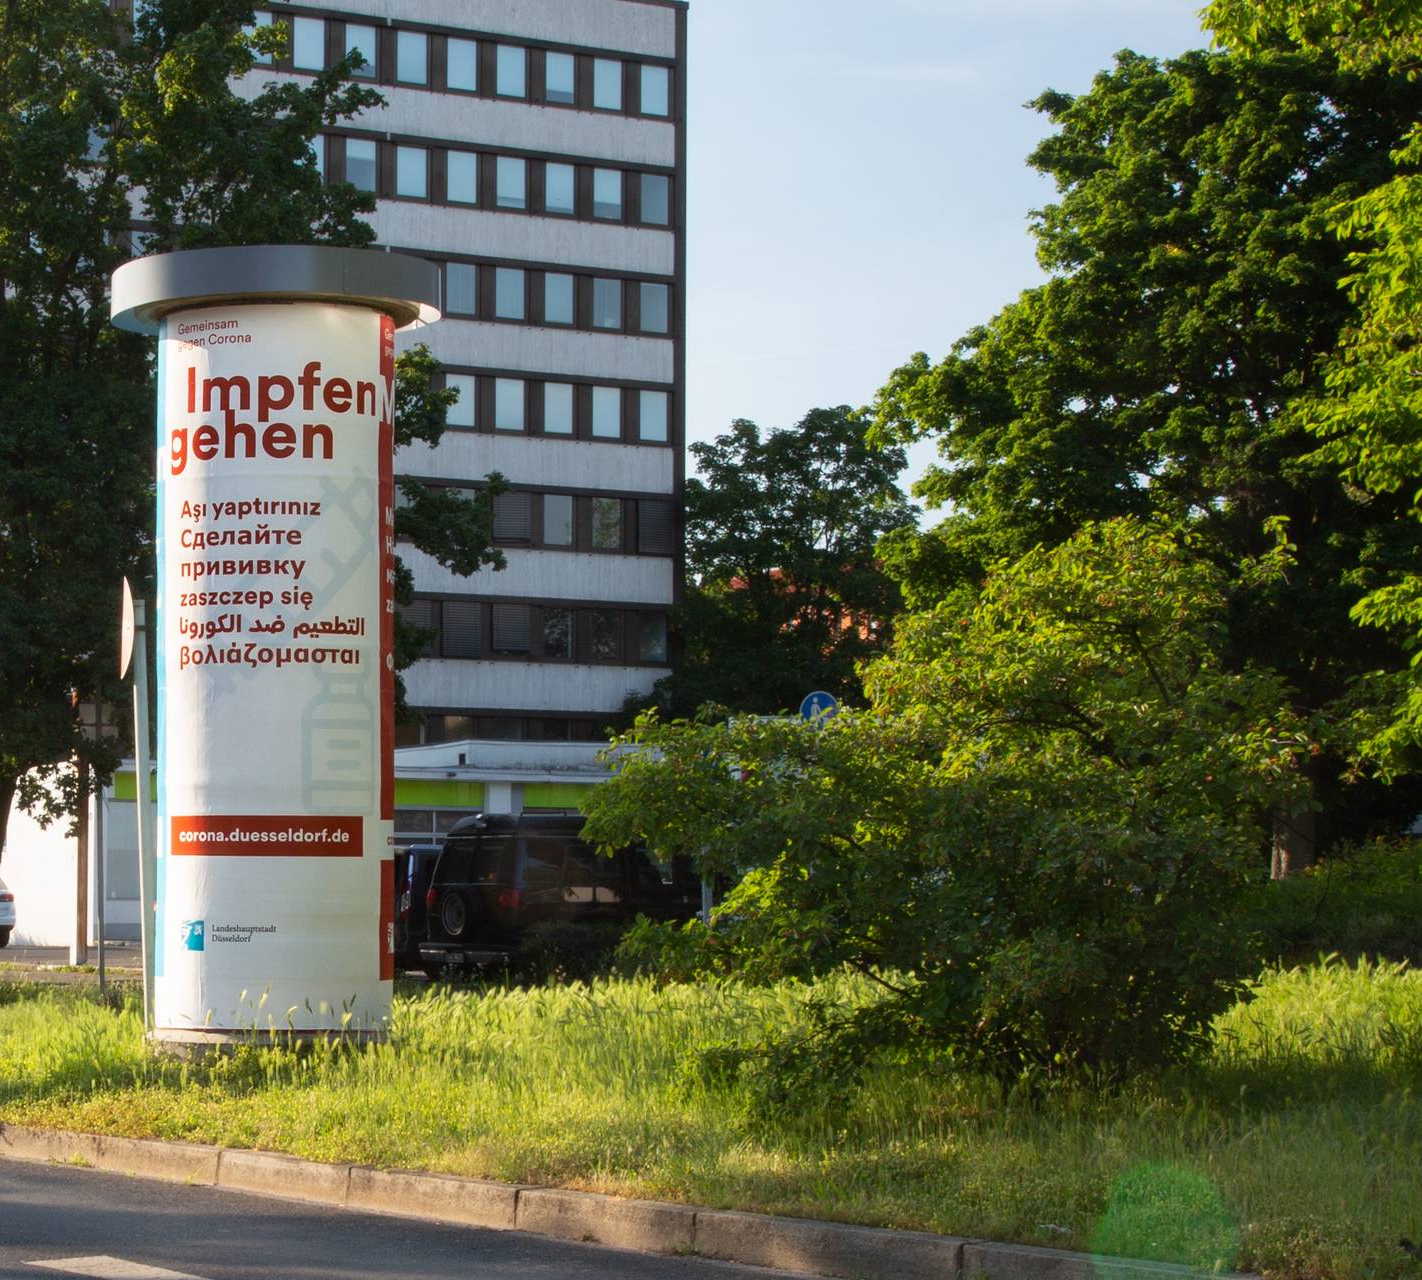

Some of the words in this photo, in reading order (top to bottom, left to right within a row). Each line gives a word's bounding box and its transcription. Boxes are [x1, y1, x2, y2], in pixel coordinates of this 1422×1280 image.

[178, 320, 239, 335] Gemeinsam
[178, 338, 206, 352] gegen
[208, 333, 252, 345] Corona
[187, 361, 376, 423] Impfen
[171, 409, 334, 475] gehen
[180, 501, 207, 522] Aşı
[212, 498, 321, 520] yaptırınız
[180, 523, 302, 550] Сделайте
[180, 558, 306, 581] прививку
[180, 589, 274, 609] zaszczep
[280, 585, 314, 610] się
[180, 614, 242, 640] الكورونا
[248, 615, 286, 635] ضد
[293, 616, 365, 638] التطعيم
[179, 828, 350, 843] corona.duesseldorf.de
[211, 924, 277, 936] Landeshauptstadt
[211, 934, 251, 943] Düsseldorf
